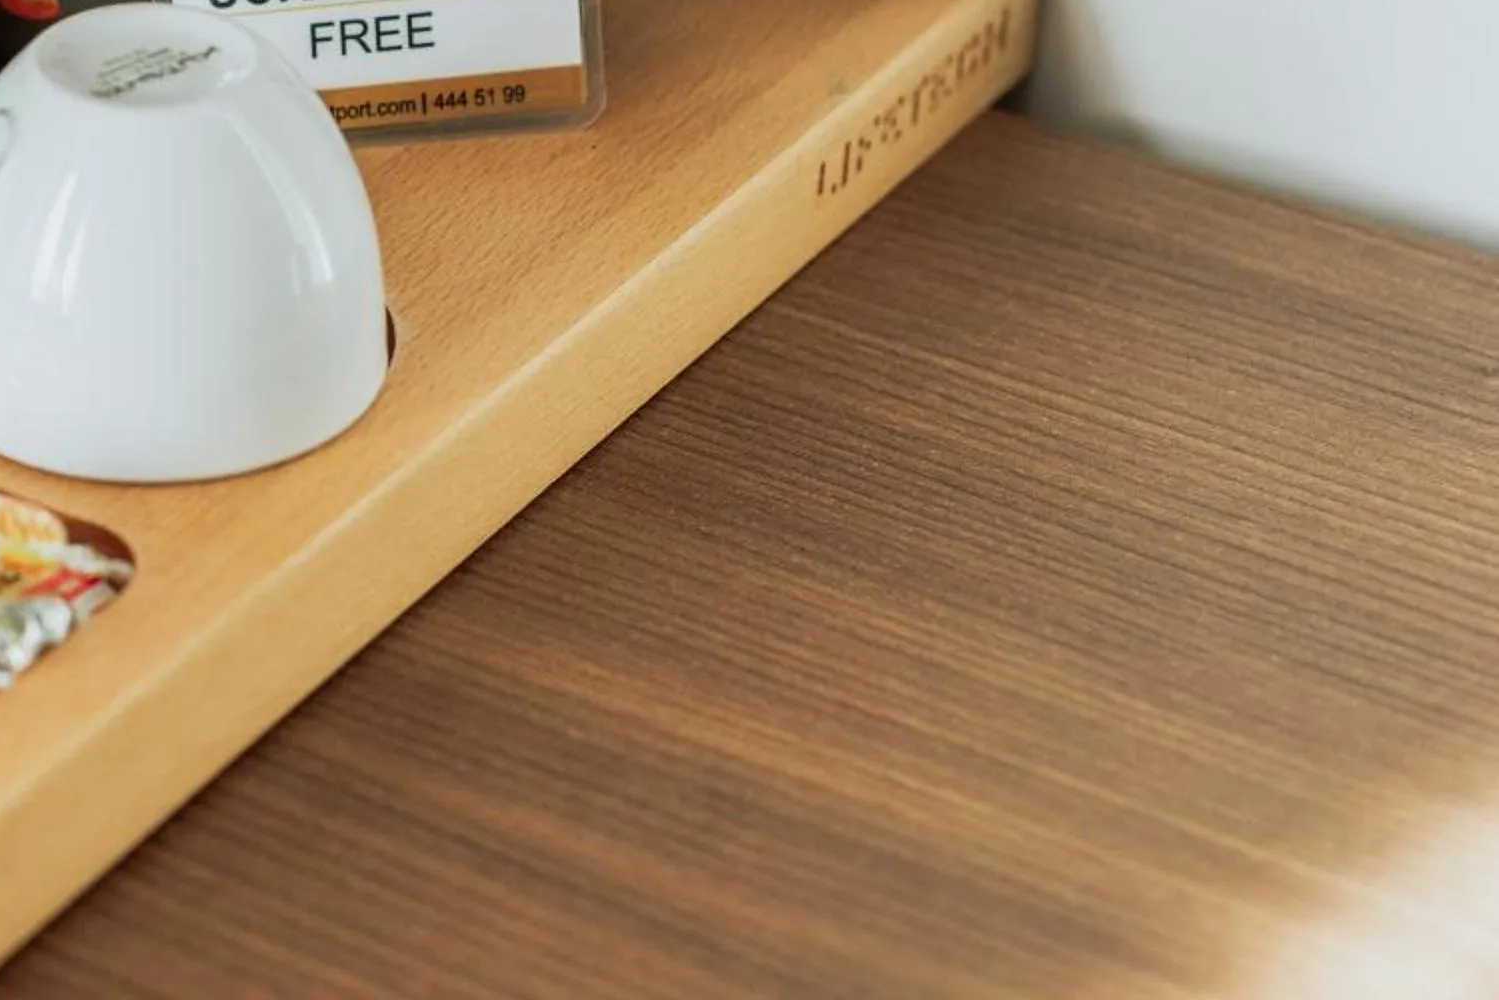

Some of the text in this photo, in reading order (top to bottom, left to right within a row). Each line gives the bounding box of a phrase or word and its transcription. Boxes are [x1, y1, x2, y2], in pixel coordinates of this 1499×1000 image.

[310, 11, 435, 59] FREE
[433, 91, 467, 109] 444
[474, 87, 495, 106] 51
